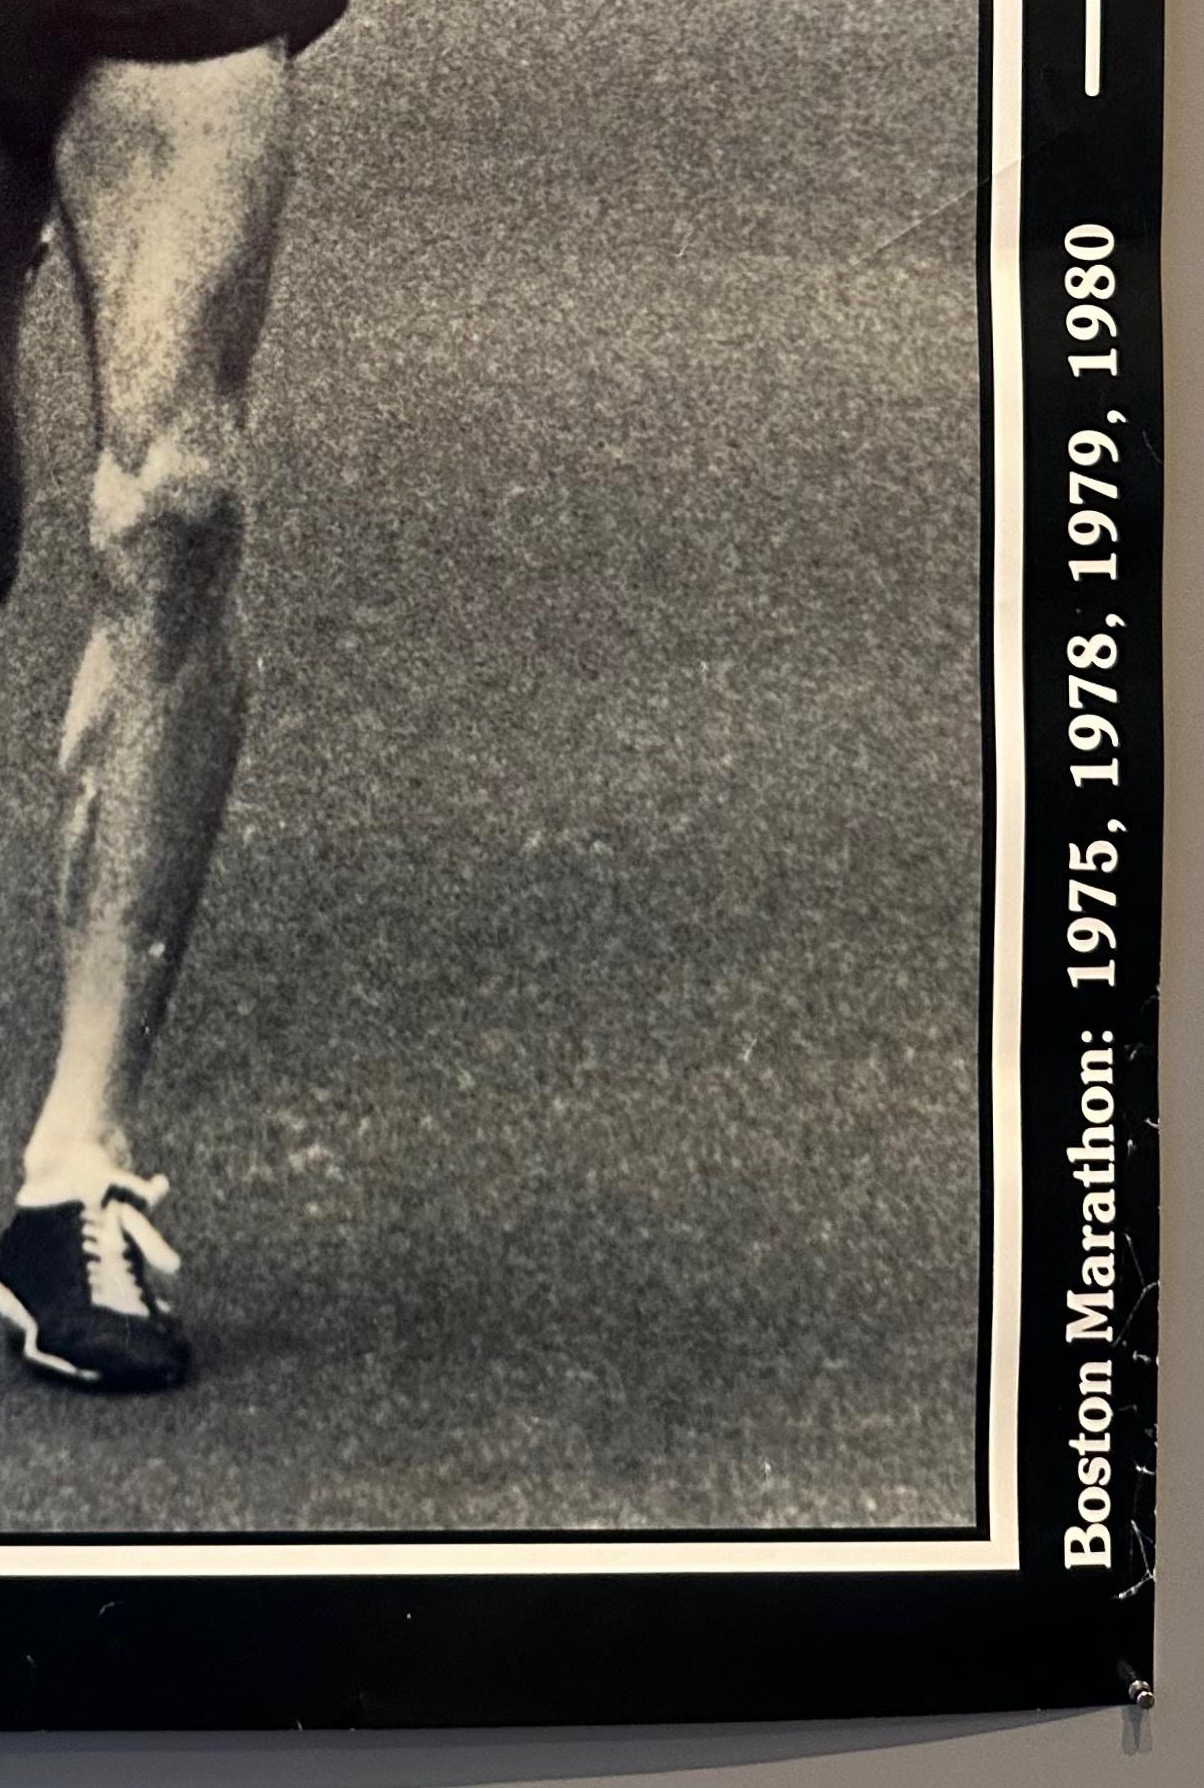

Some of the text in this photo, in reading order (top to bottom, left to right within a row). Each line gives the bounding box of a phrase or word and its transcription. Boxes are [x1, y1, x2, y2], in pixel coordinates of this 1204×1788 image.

[1065, 224, 1117, 377] 1980
[1068, 410, 1126, 581] 1979,
[1067, 614, 1126, 786] 1978,
[1067, 819, 1126, 987] 1975,
[1066, 1031, 1116, 1342] Marathon:
[1064, 1359, 1115, 1569] Boston
